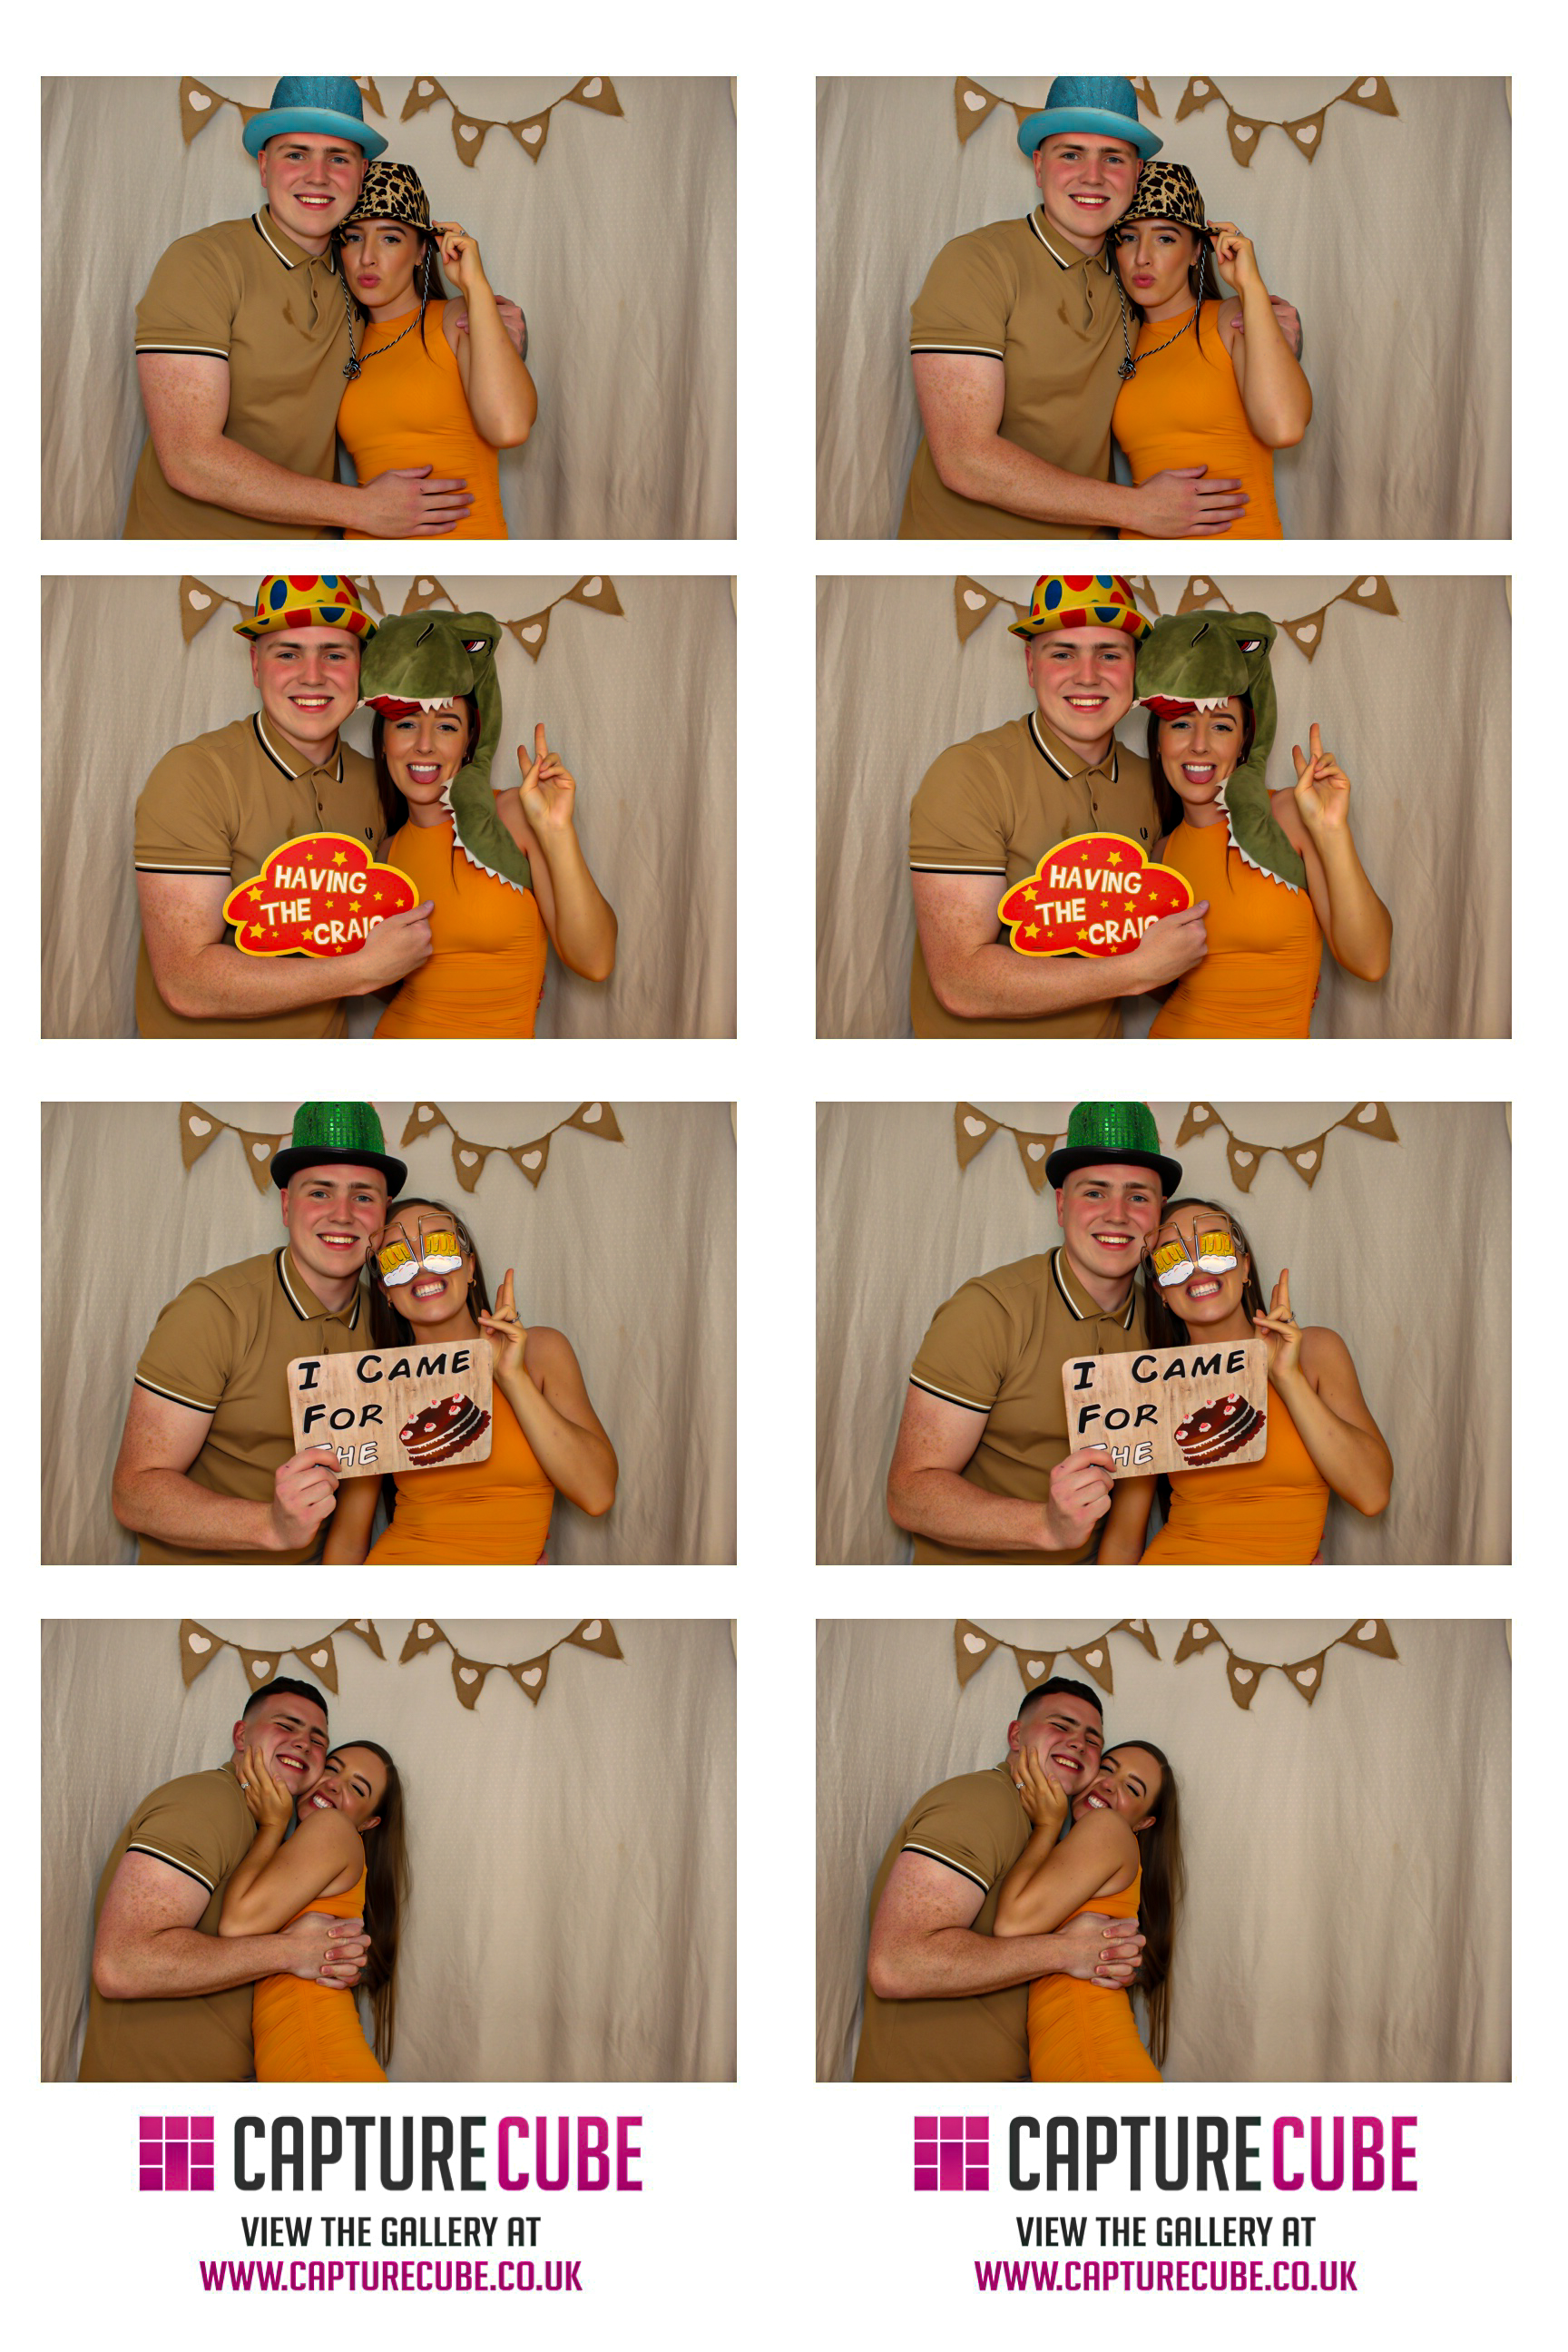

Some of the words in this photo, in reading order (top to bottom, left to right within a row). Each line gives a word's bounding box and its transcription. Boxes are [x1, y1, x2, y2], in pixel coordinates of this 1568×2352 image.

[274, 865, 368, 894] HAVING
[1049, 865, 1142, 894] HAVING
[260, 897, 311, 926] THE
[1034, 897, 1086, 926] THE
[299, 1361, 320, 1390] I
[357, 1349, 470, 1383] CAME
[1073, 1361, 1095, 1390] I
[1132, 1349, 1245, 1383] CAME
[303, 1404, 383, 1434] FOR
[1078, 1404, 1158, 1434] FOR
